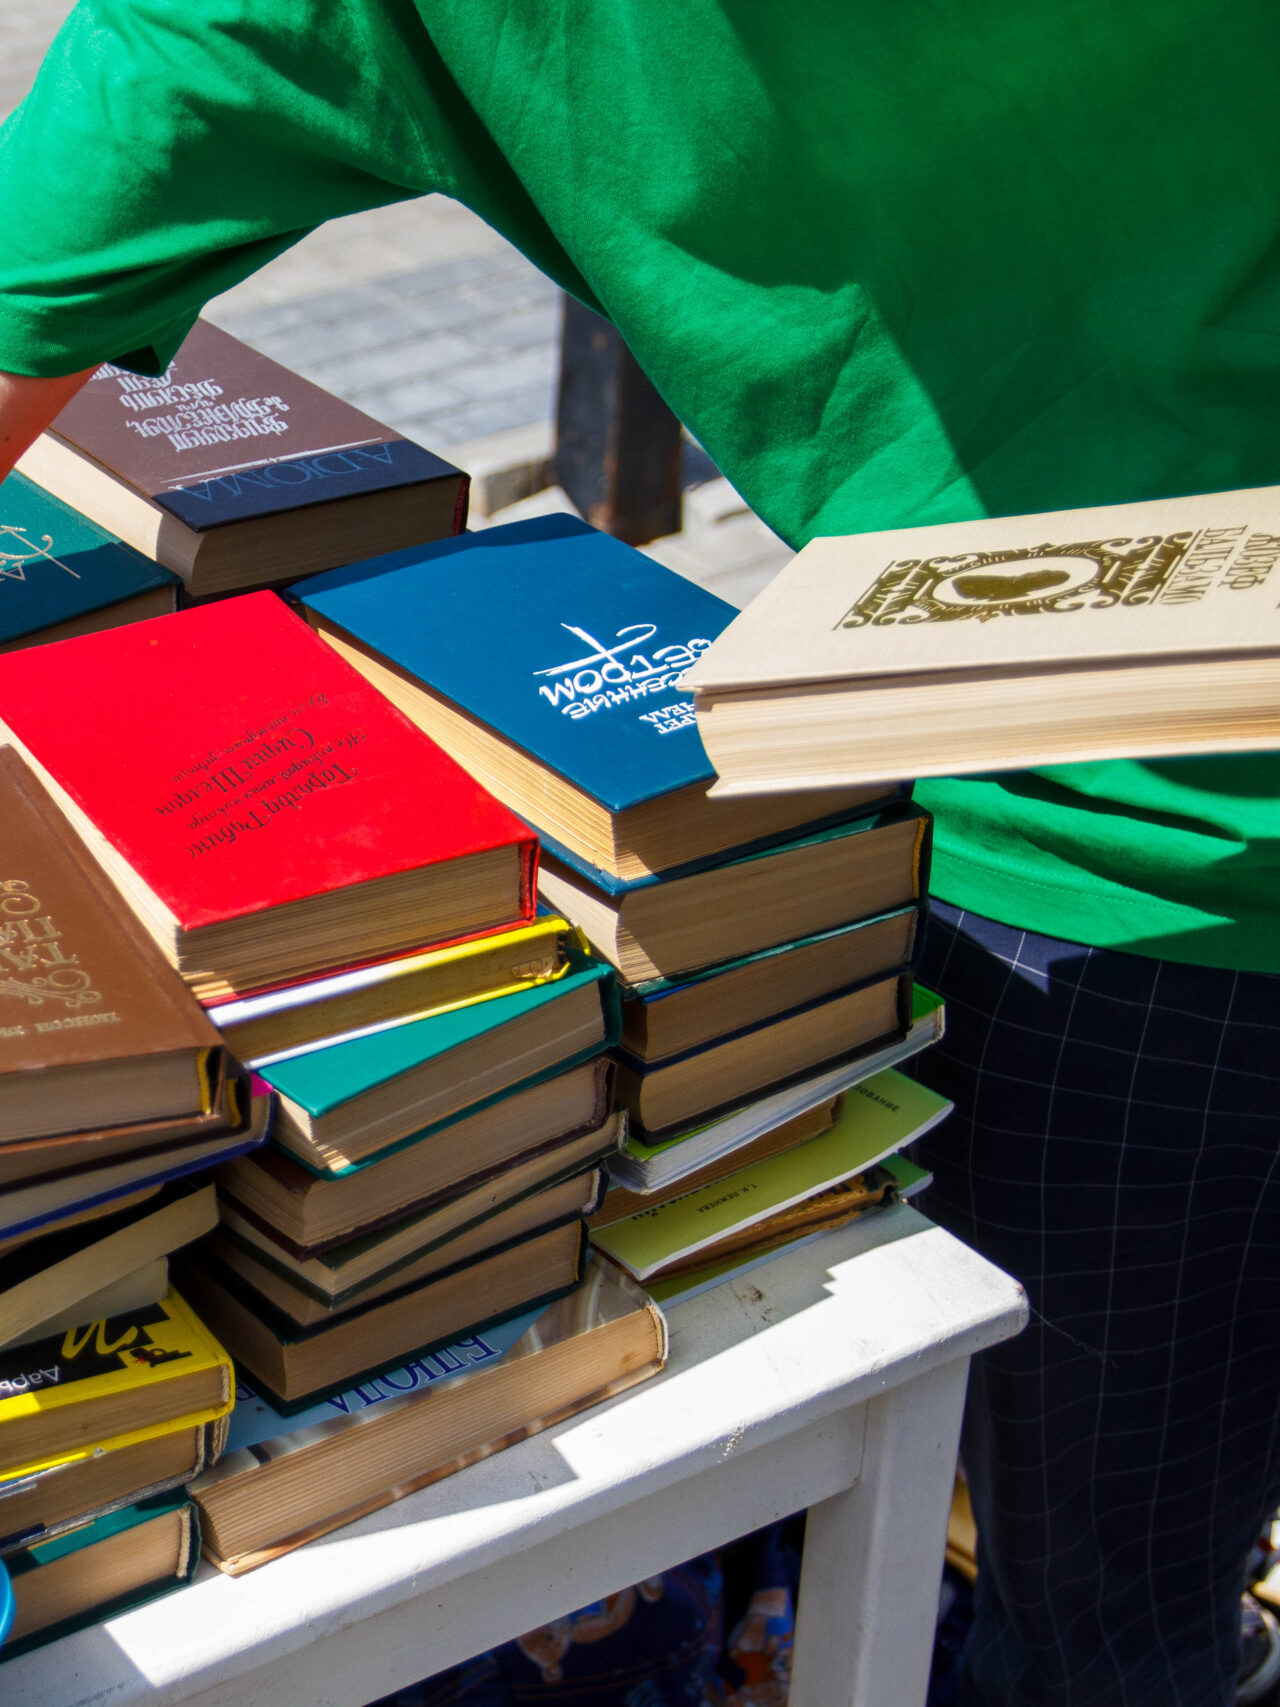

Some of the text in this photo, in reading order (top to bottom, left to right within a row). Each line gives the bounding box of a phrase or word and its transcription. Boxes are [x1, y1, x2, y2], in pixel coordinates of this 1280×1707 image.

[1158, 524, 1249, 606] БАЛЬЗАМО
[154, 727, 315, 817] Сидни Шелдон
[261, 762, 359, 815] Гарольд
